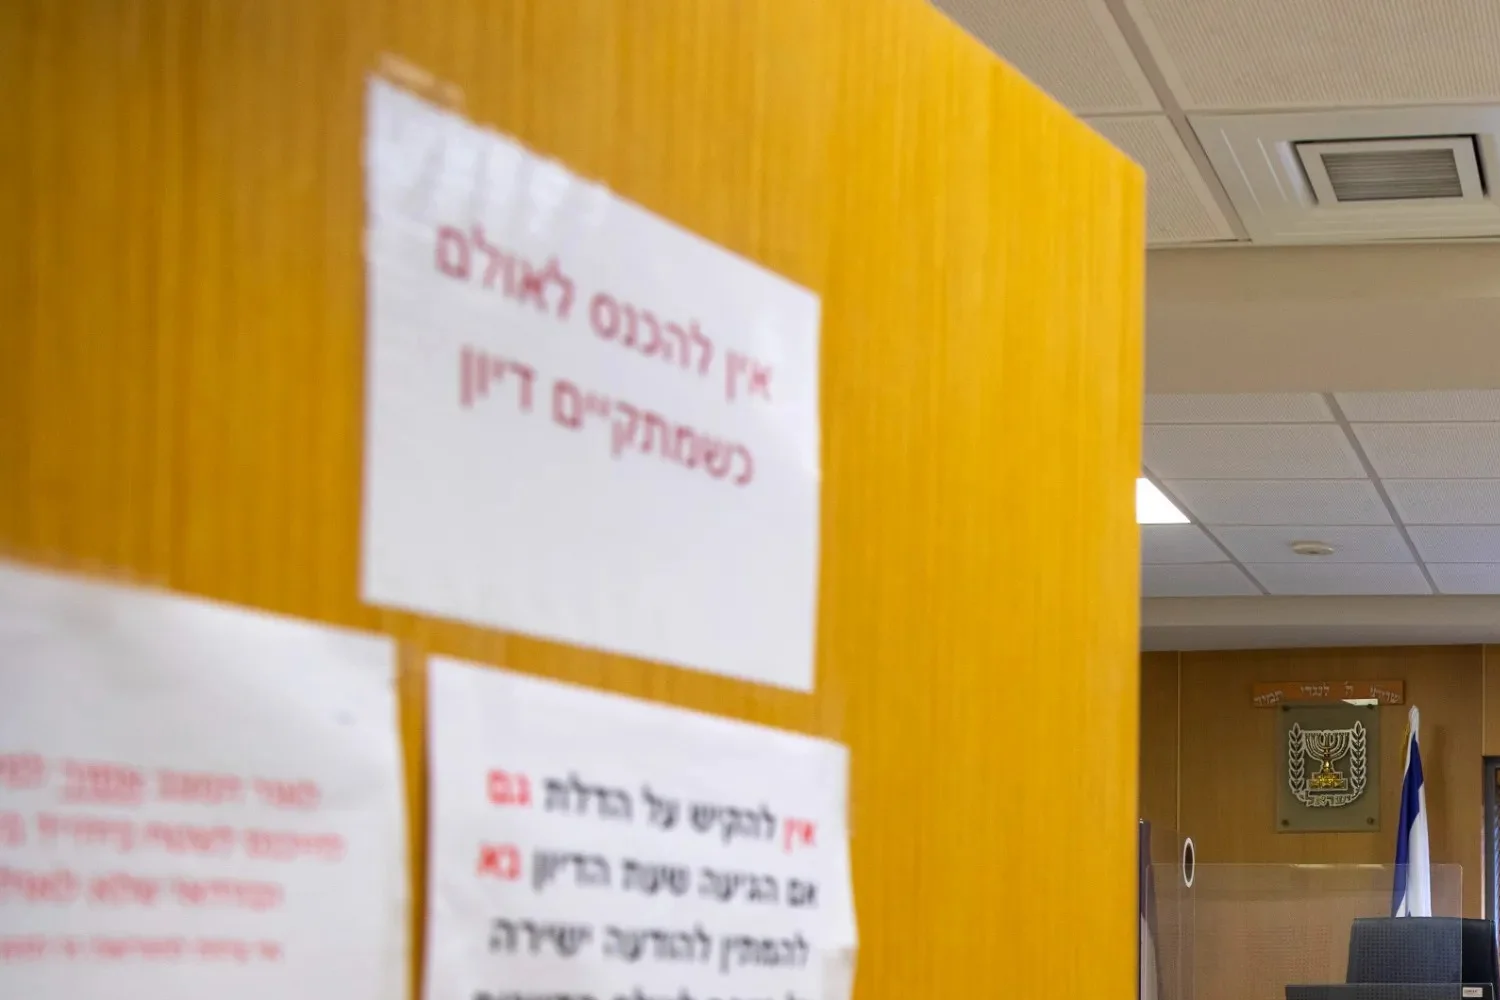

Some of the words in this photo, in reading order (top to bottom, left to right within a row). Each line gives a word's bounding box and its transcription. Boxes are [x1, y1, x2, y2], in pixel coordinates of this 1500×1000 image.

[434, 222, 576, 320] לאולם
[589, 291, 714, 376] להכנס
[459, 345, 537, 412] דיון
[725, 350, 773, 401] אין
[552, 379, 755, 487] כשמתקיים
[486, 769, 531, 807] גם
[544, 772, 632, 818] הדלת
[642, 786, 680, 831] על
[689, 802, 776, 844] להקיש
[783, 816, 817, 852] אין
[531, 851, 611, 892] הדיון
[622, 858, 690, 897] שעת
[699, 867, 778, 903] הגיעה
[786, 877, 818, 908] אם
[488, 917, 593, 957] ישירה
[603, 924, 712, 964] להודעה
[720, 933, 810, 973] להמתין
